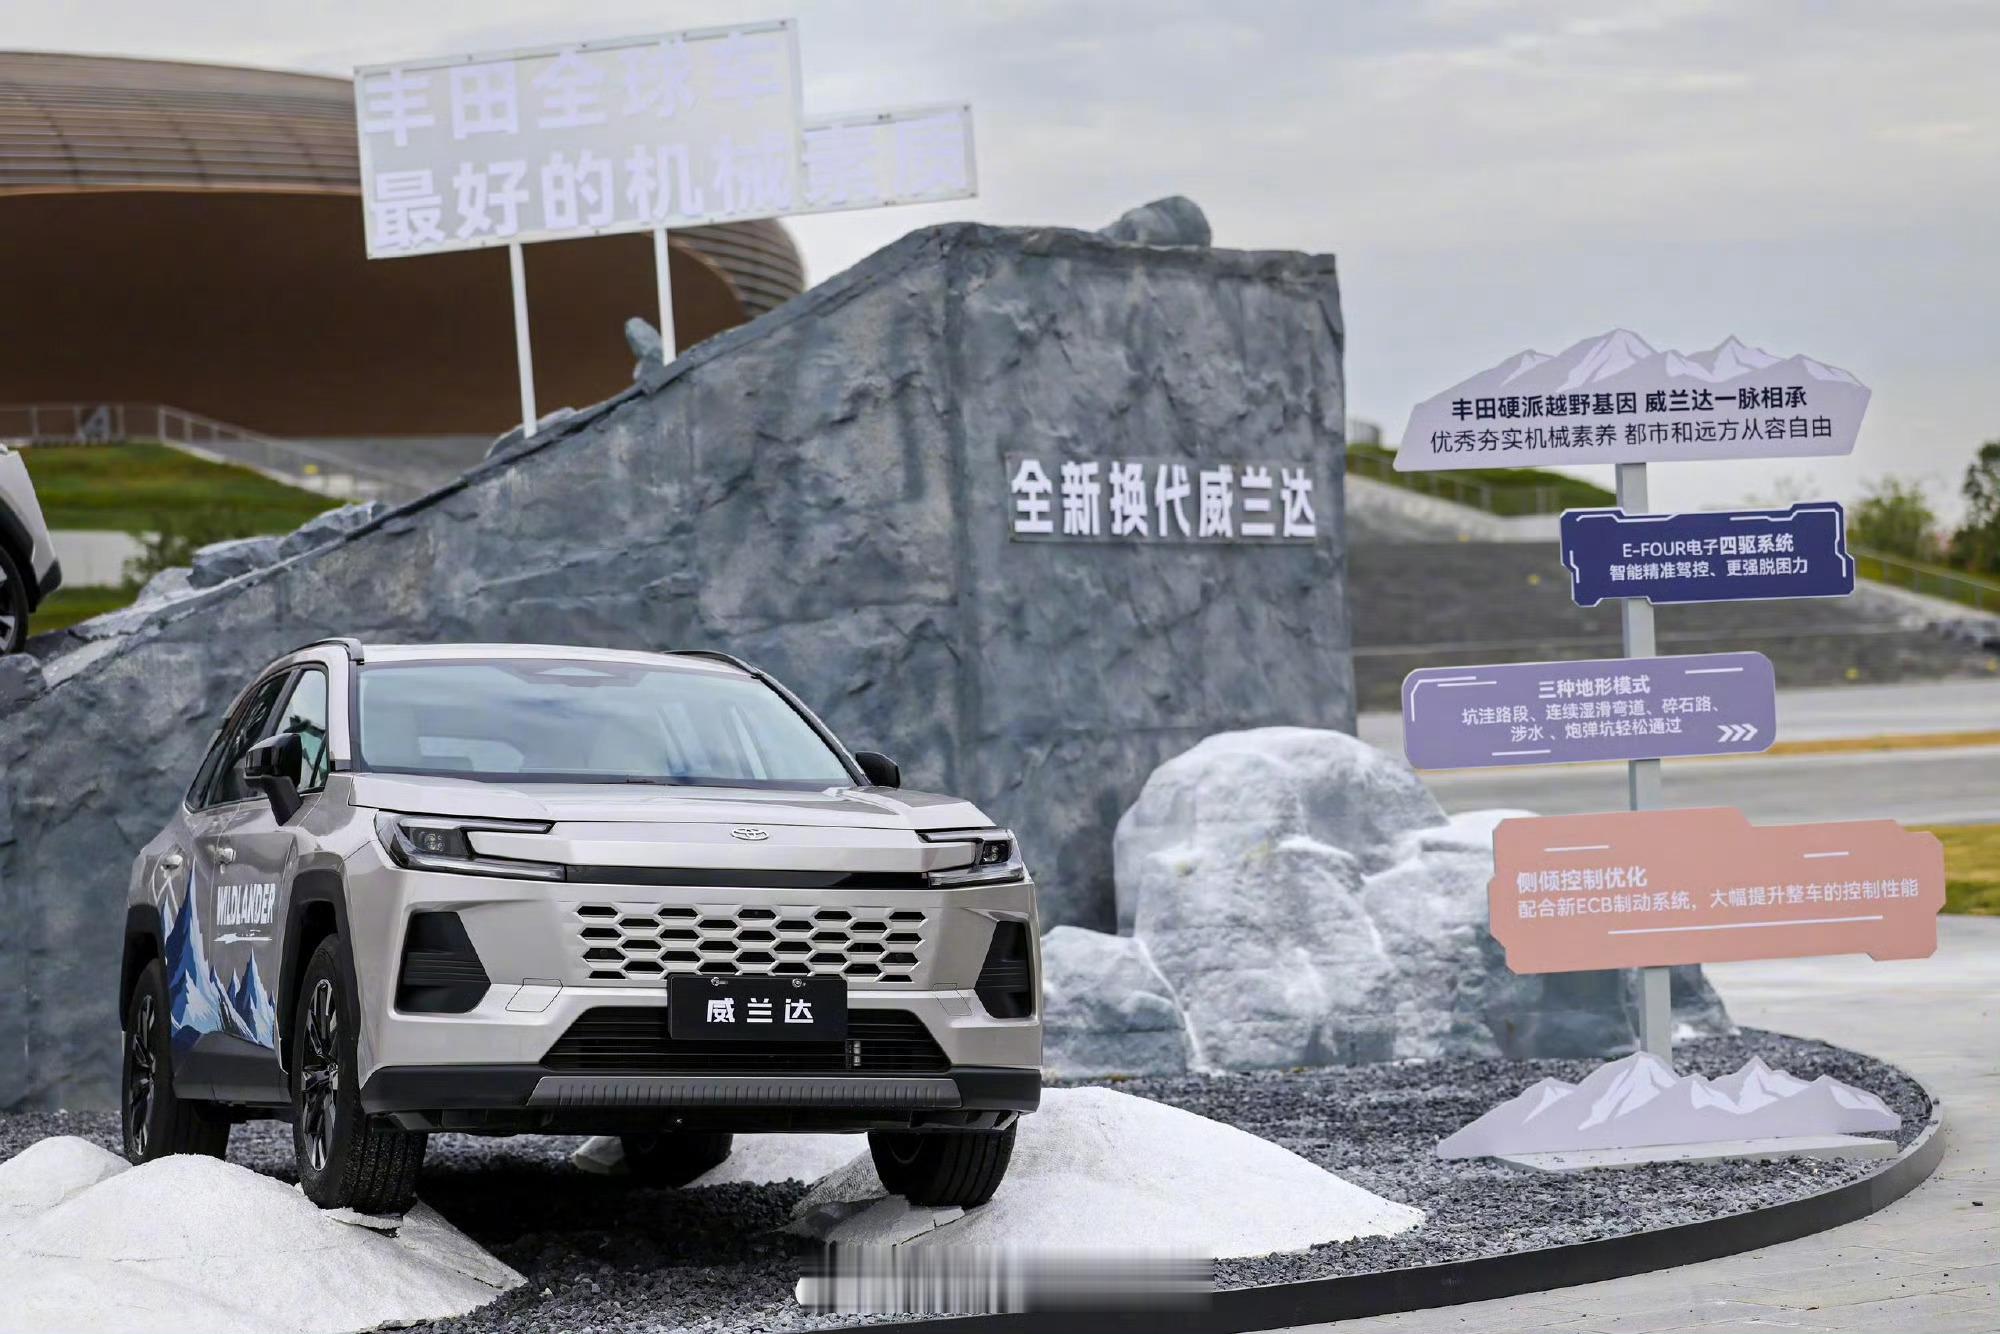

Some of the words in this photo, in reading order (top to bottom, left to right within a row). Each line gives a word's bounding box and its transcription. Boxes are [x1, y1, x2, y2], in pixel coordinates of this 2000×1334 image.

[364, 32, 786, 147] 丰田全球车
[1451, 391, 1637, 421] 丰田硬派越野基因
[1645, 386, 1808, 413] 威兰达一脉相承
[1430, 424, 1617, 454] 优秀夯实机械素养
[1624, 415, 1832, 445] 都市和远方从容自由
[1011, 459, 1317, 537] 全新换代威兰达
[1622, 533, 1794, 558] E-FOUR电子四驱系统
[1609, 557, 1808, 581] 智能精准驾控、更强脱困力
[1538, 674, 1651, 699] 三种地形模式
[1516, 866, 1648, 894] 侧倾控制优化
[216, 883, 276, 926] WILDLANDER
[706, 997, 814, 1024] 威兰达
